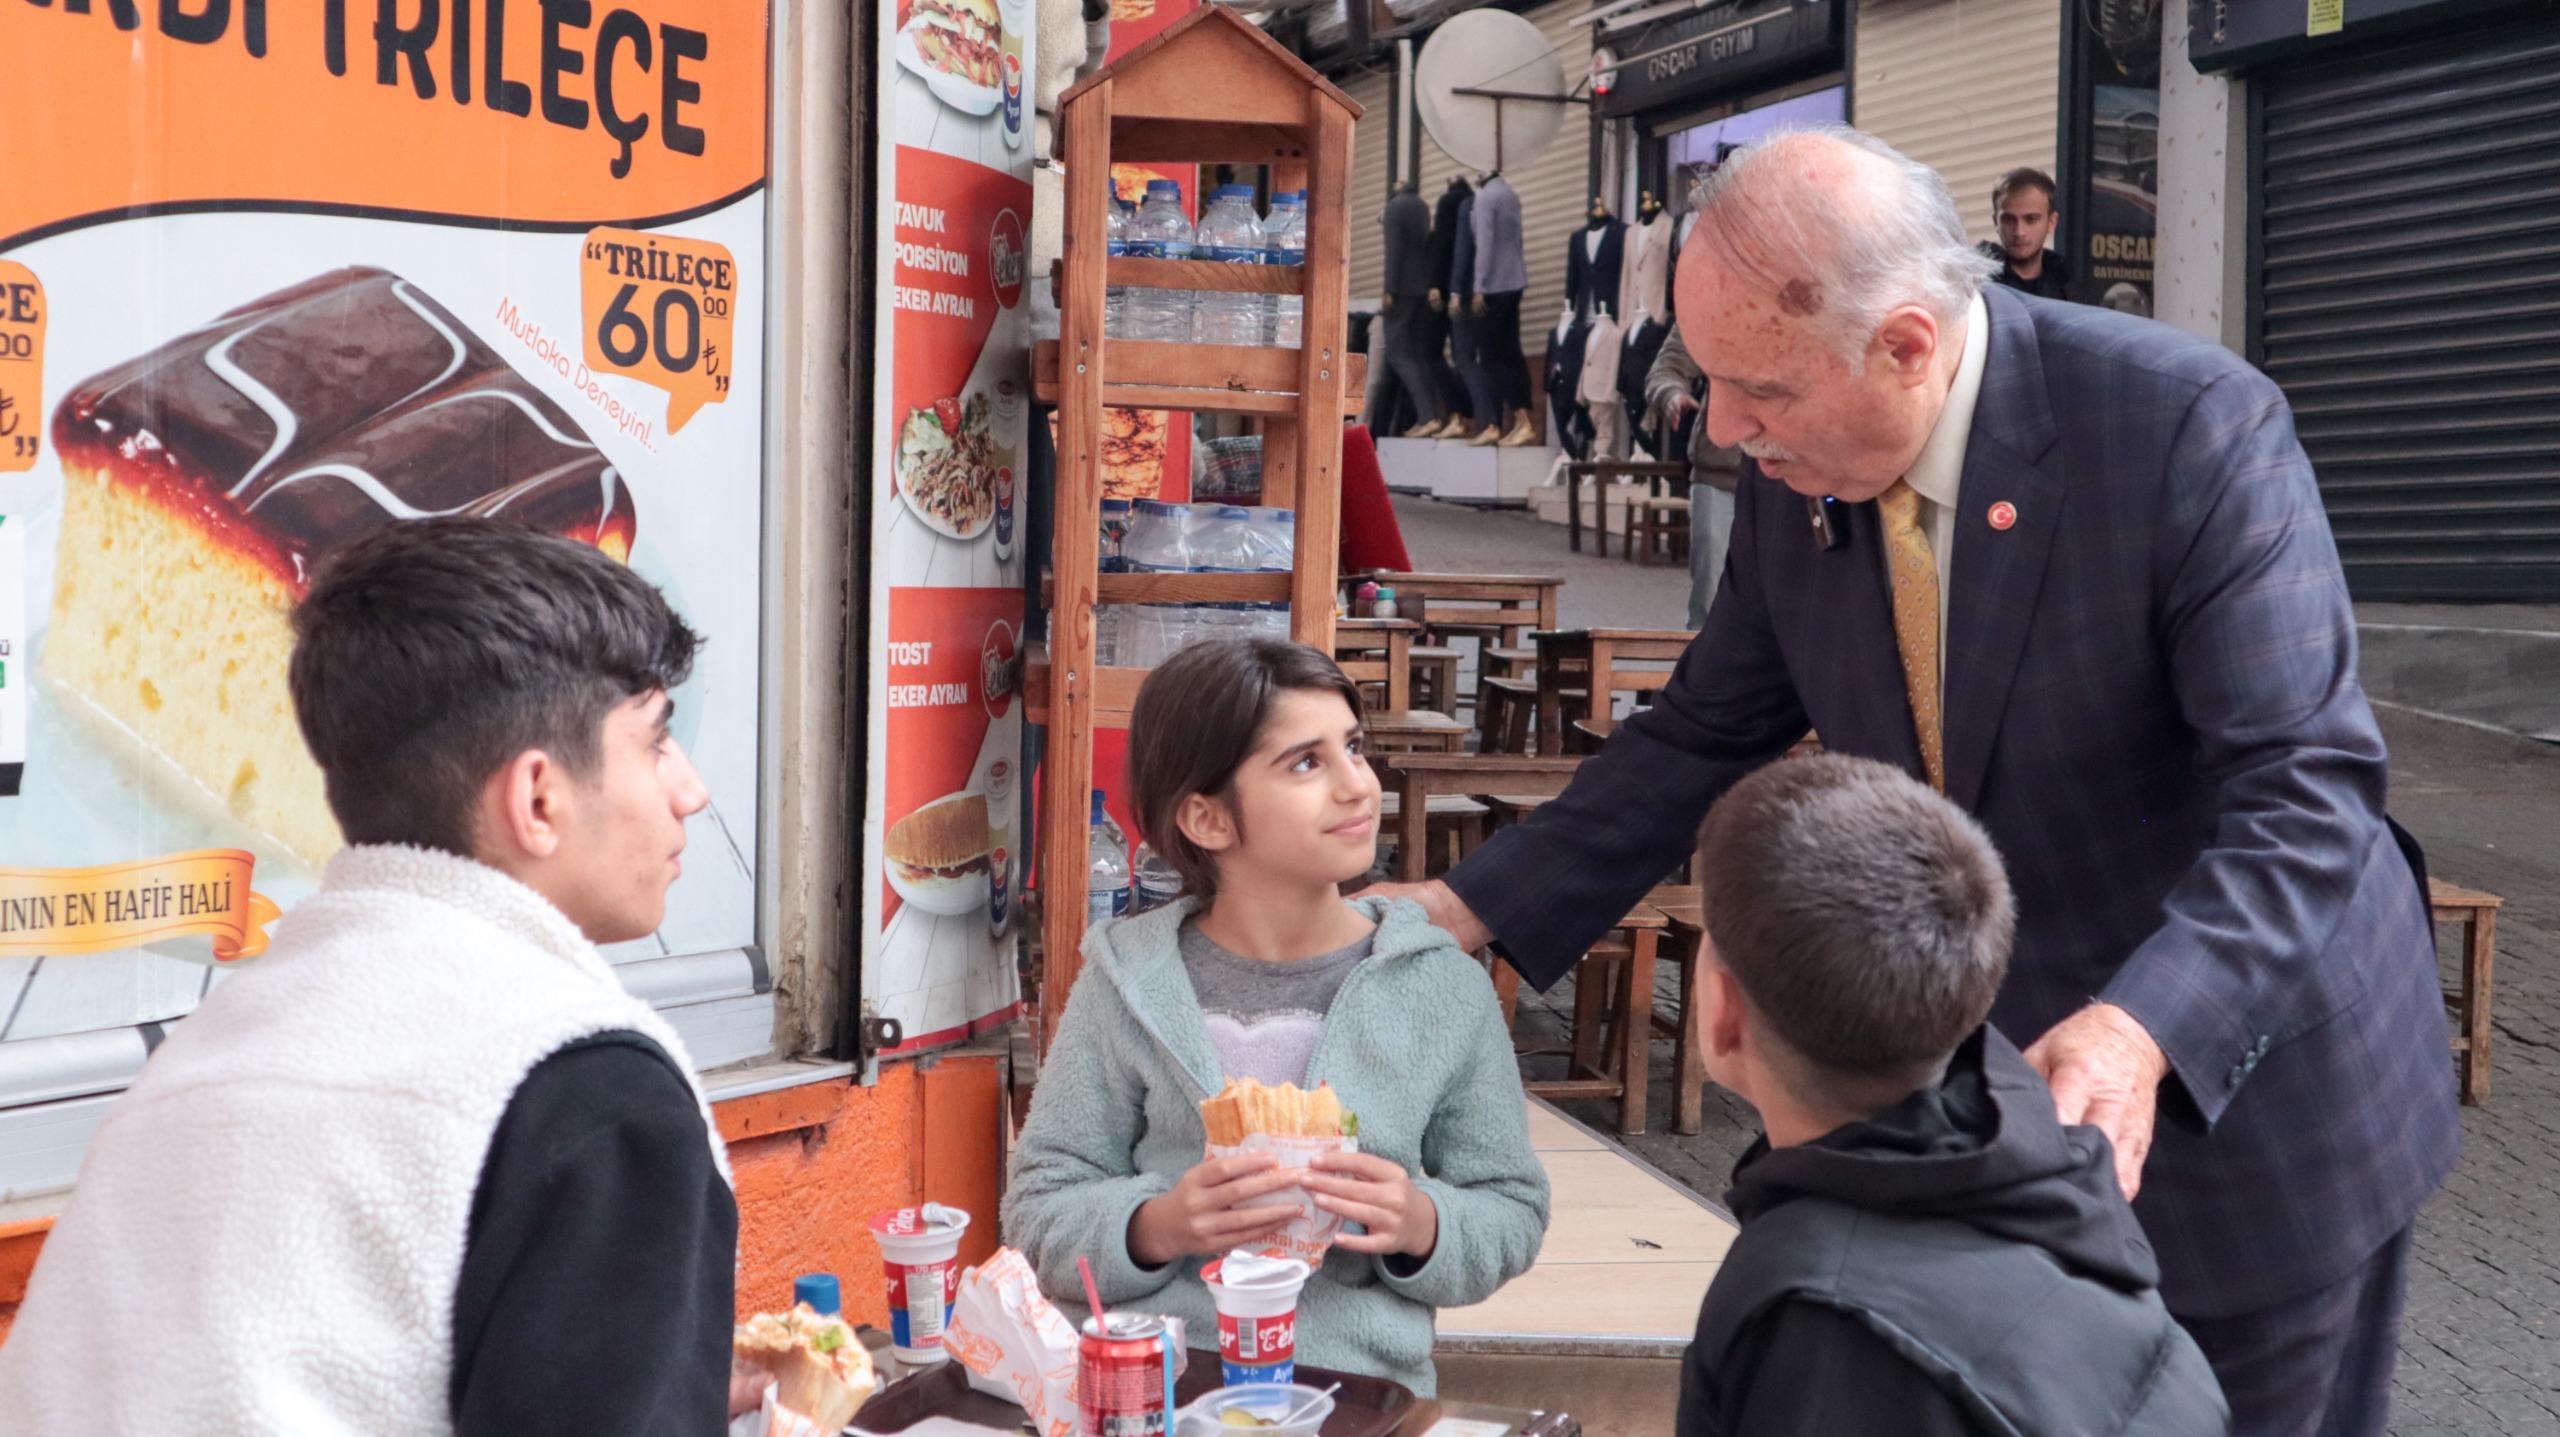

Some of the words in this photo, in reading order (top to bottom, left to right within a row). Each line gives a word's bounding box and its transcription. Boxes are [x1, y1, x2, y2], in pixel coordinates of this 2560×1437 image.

[1648, 46, 1699, 81] OSCAR
[895, 201, 945, 233] TAVUK
[895, 241, 968, 277] PORSİYON
[894, 285, 931, 312] EKER
[932, 292, 974, 319] AYRAN
[496, 297, 570, 378] Mutlaka
[598, 283, 700, 374] 60
[703, 296, 728, 317] 00
[888, 642, 931, 666] TOST
[888, 684, 927, 707] EKER
[929, 683, 967, 706] AYRAN
[64, 891, 97, 927] EN
[104, 878, 172, 923] HAFİF
[179, 873, 232, 916] HALİ
